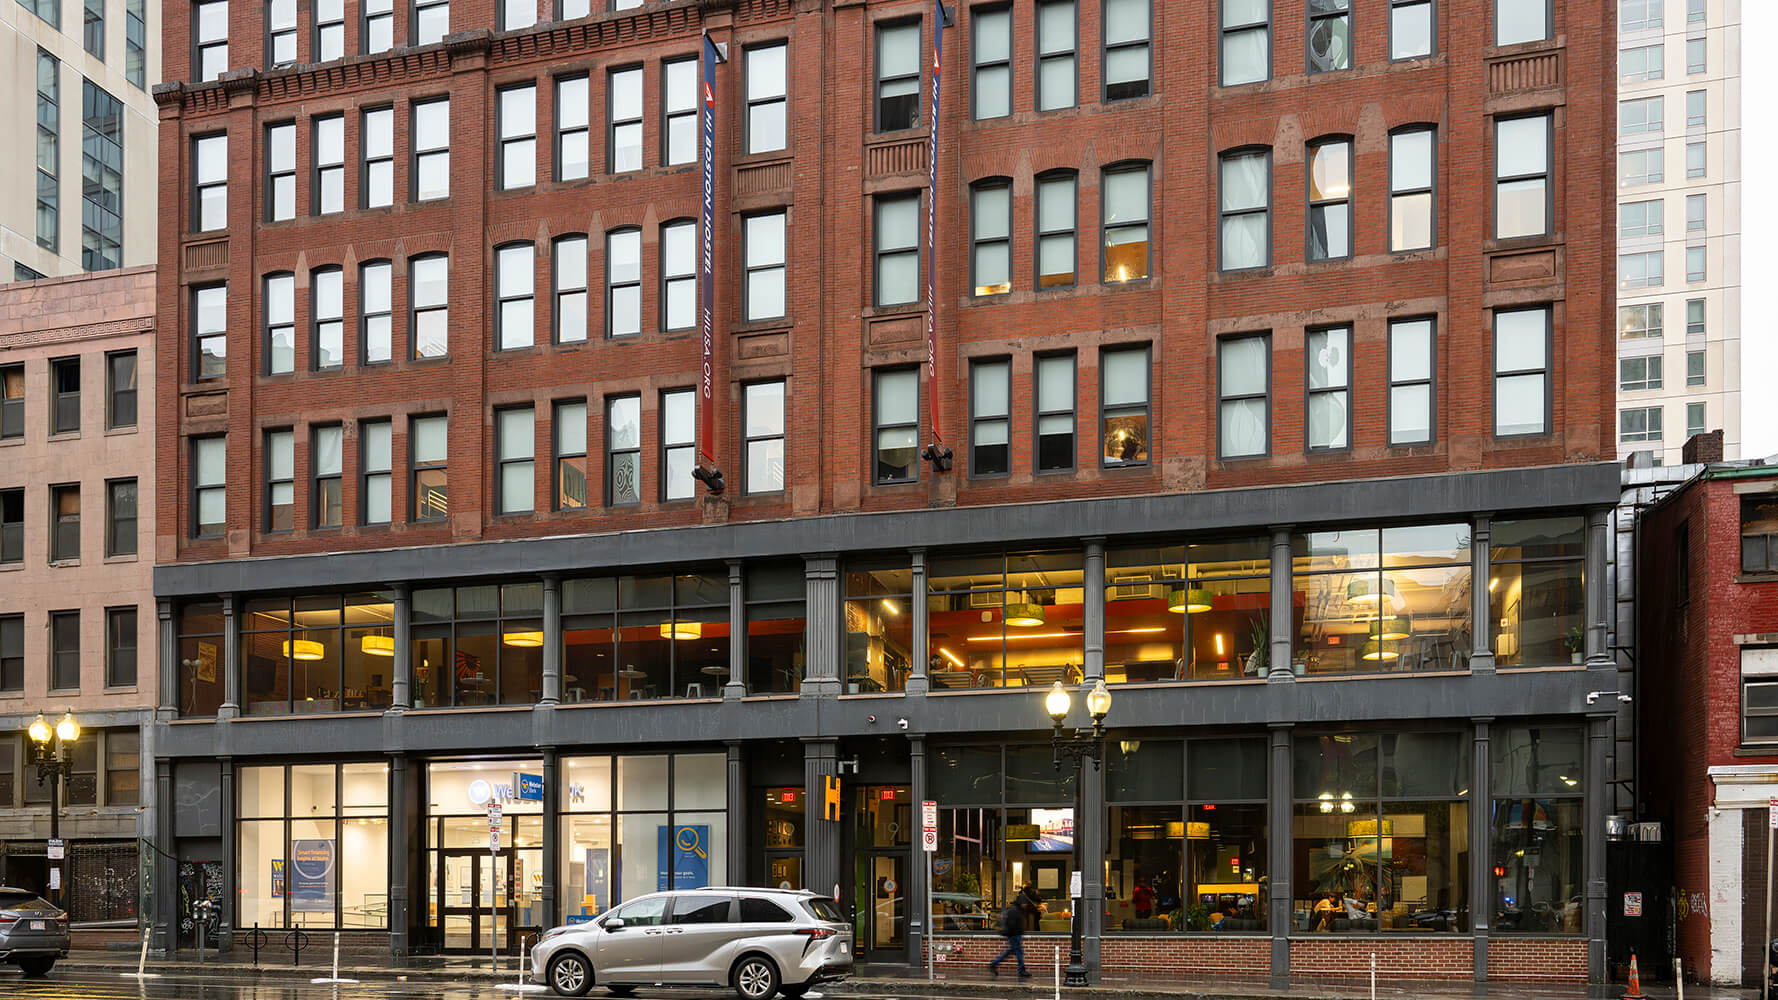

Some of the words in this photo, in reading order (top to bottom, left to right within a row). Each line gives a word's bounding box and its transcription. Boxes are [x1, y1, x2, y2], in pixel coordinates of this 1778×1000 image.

[705, 110, 713, 133] HI
[704, 137, 713, 211] BOSTON
[704, 213, 712, 275] HOSTEL
